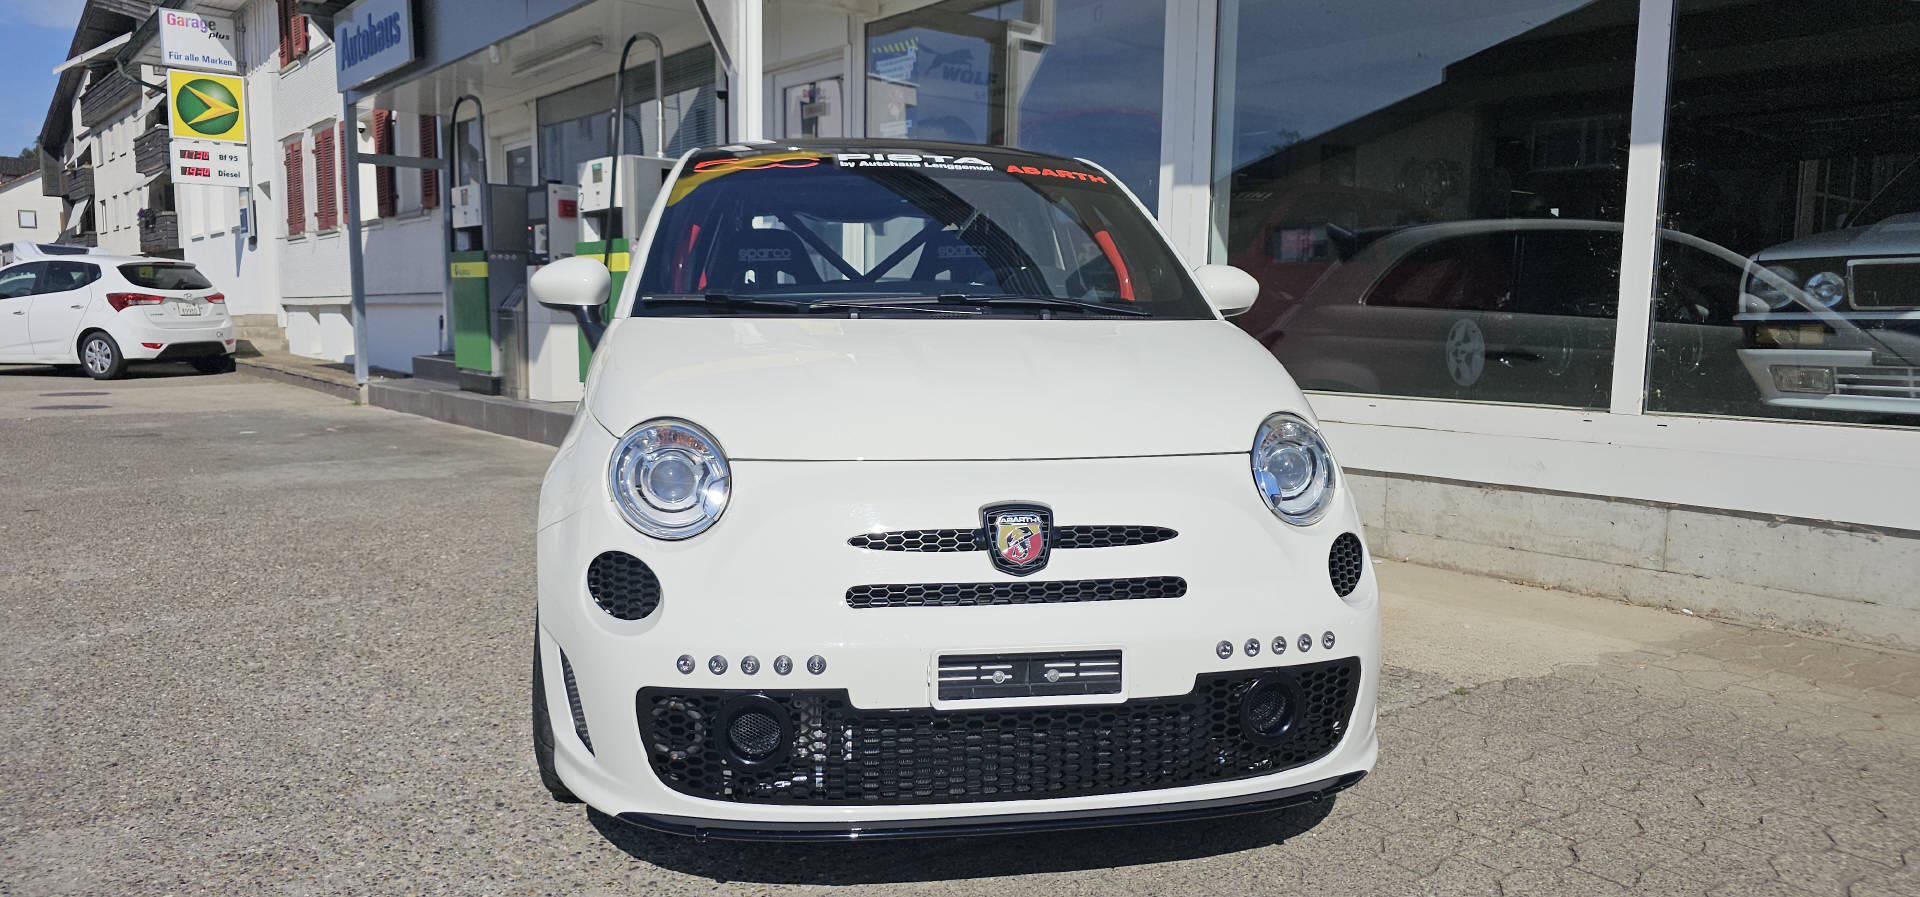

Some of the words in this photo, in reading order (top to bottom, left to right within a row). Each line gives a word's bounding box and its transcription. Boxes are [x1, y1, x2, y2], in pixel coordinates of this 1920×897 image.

[167, 13, 216, 33] Garage
[208, 32, 230, 40] plus
[341, 11, 401, 71] Autohaus
[168, 51, 182, 60] Für
[184, 53, 200, 62] alle
[202, 55, 233, 66] Marken
[837, 153, 992, 166] PISTA
[839, 160, 855, 168] by
[859, 160, 921, 168] Autohaus
[218, 170, 241, 178] Diesel
[1006, 165, 1107, 184] ABARTH
[738, 247, 792, 261] sparco
